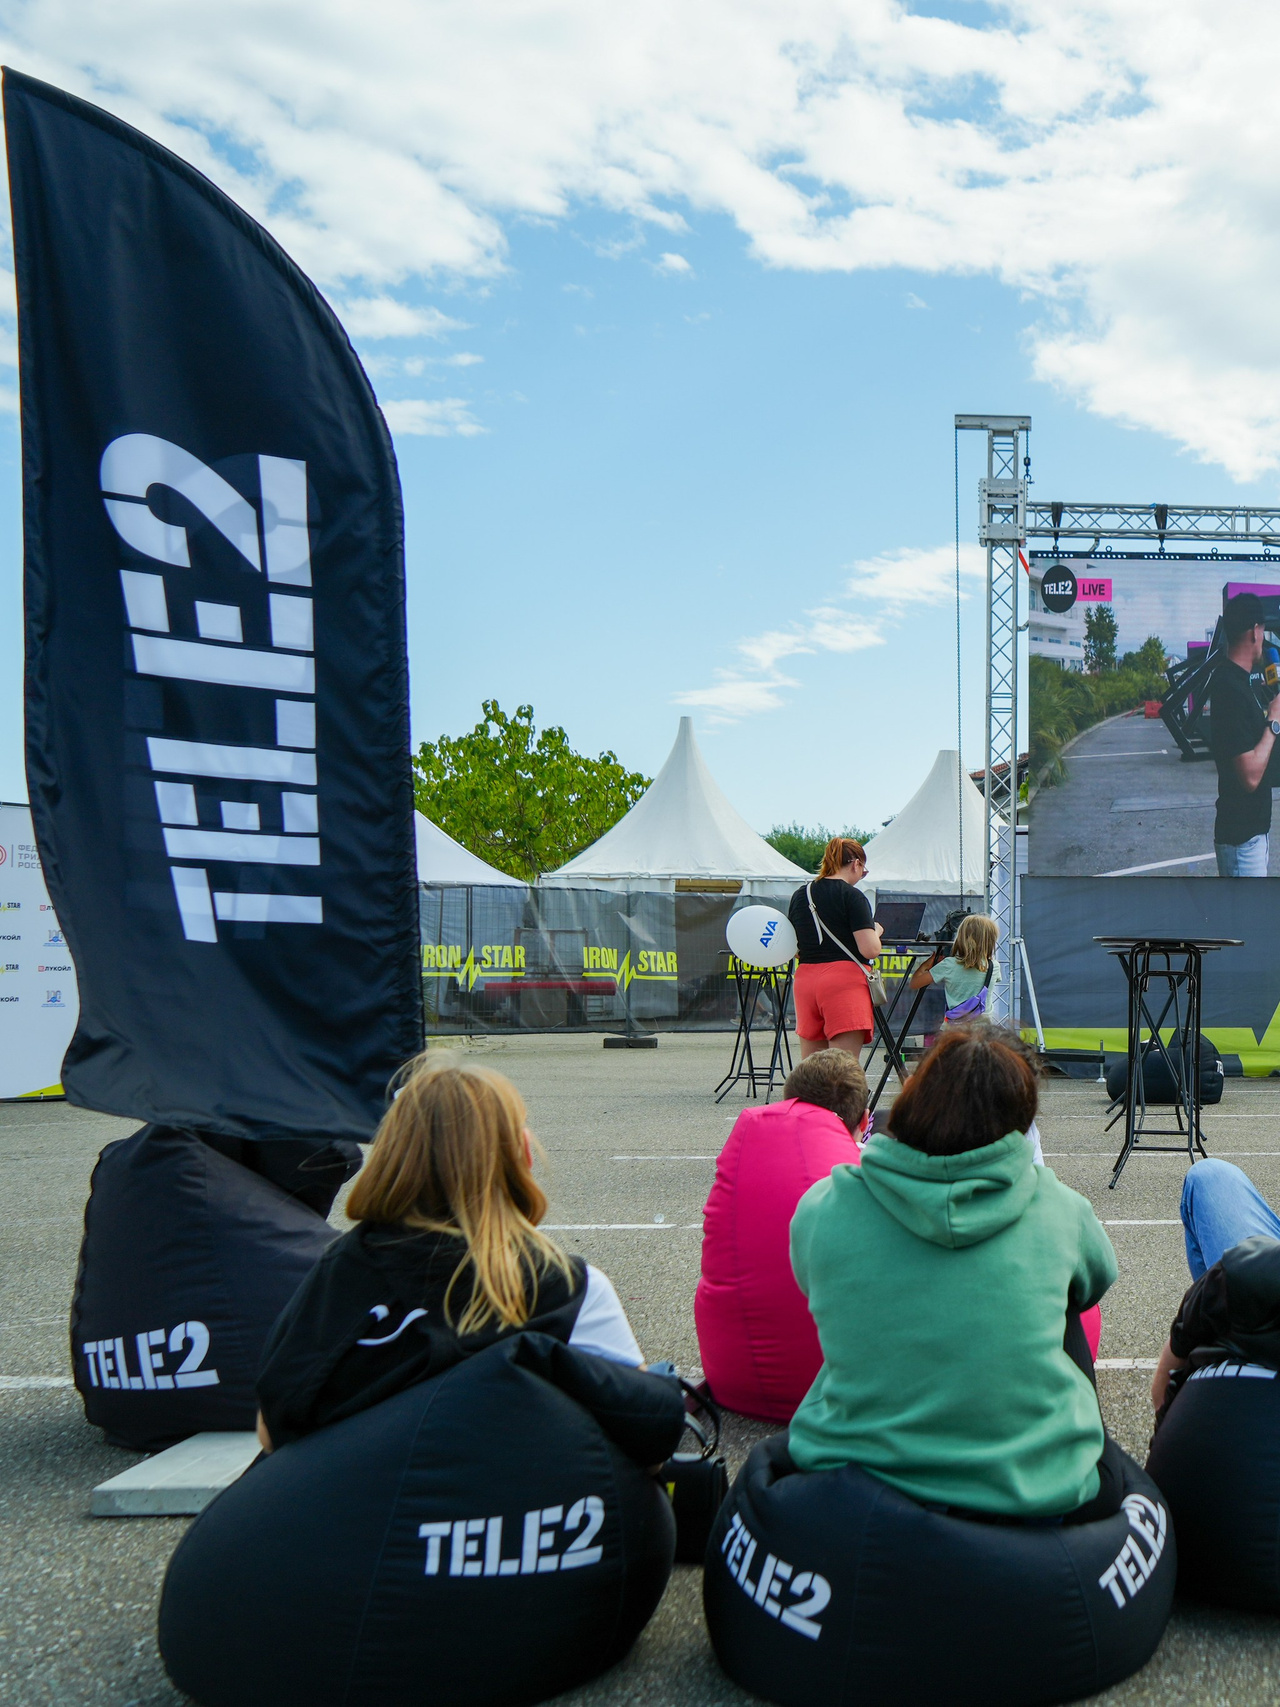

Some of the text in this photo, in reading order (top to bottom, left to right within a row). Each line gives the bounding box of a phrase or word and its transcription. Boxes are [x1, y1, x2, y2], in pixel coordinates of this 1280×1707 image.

[1044, 580, 1105, 596] TELE2 LIVE
[100, 433, 323, 943] TELE2
[481, 945, 525, 968] STAR
[583, 947, 678, 973] IRON STAR
[759, 921, 778, 948] AVA
[83, 1320, 220, 1390] TELE2
[418, 1495, 605, 1577] TELE2
[1098, 1493, 1167, 1610] TELE2
[721, 1510, 832, 1642] TELE2
